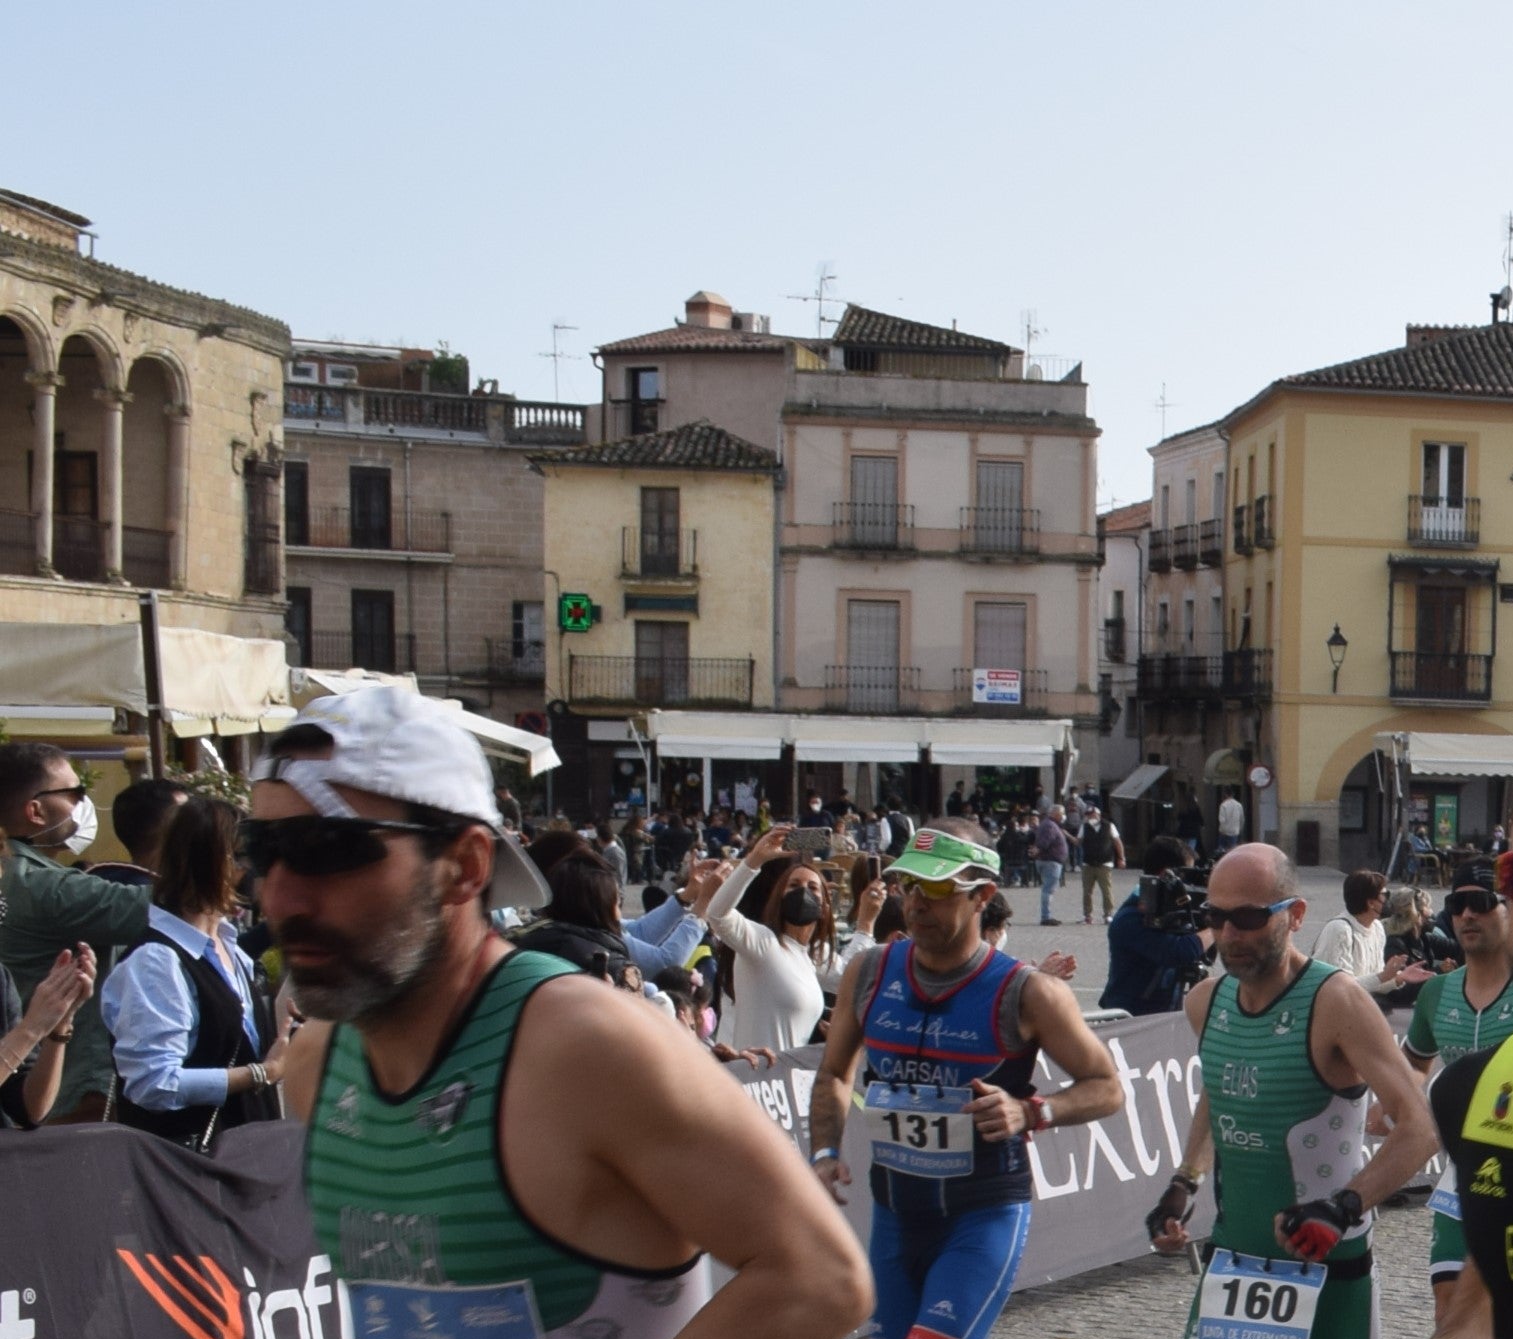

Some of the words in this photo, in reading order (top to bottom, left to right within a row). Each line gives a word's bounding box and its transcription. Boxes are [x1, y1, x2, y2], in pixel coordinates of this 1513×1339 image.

[880, 1056, 960, 1088] CARSAN
[882, 1111, 950, 1150] 131
[1222, 1278, 1299, 1323] 160
